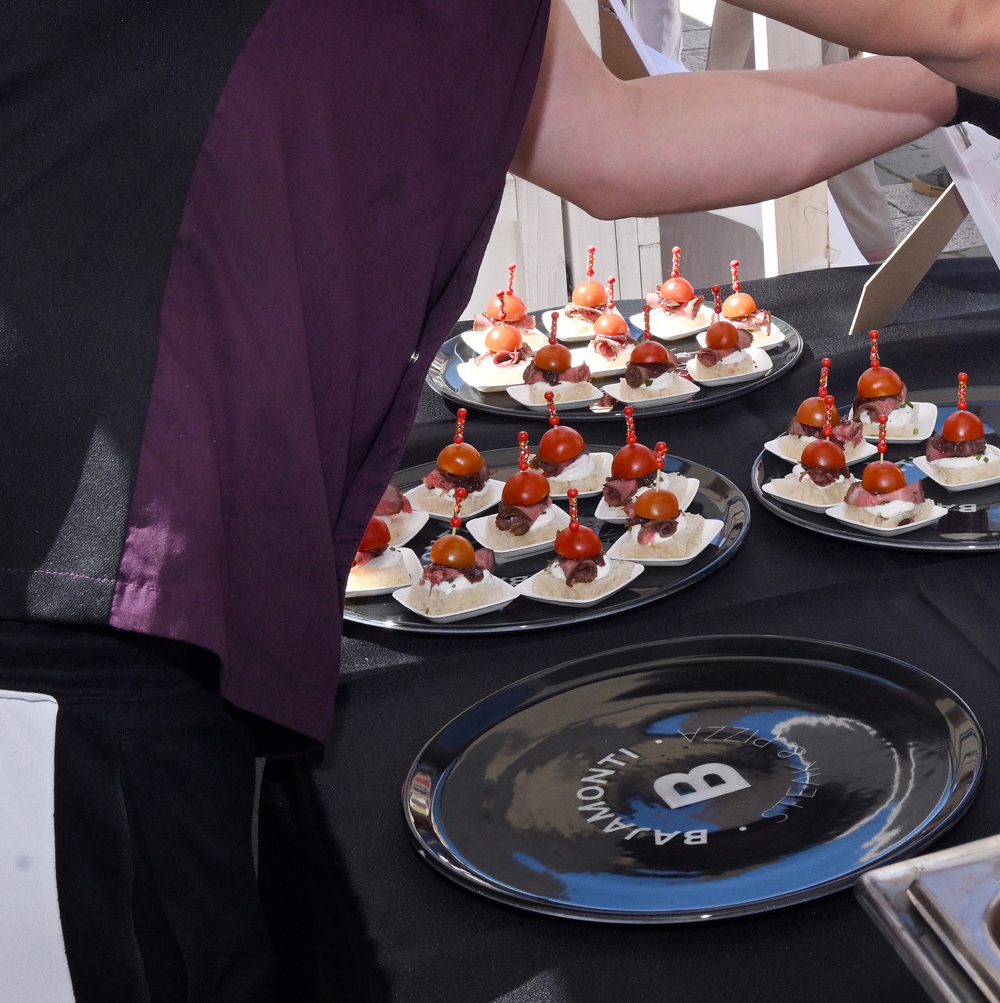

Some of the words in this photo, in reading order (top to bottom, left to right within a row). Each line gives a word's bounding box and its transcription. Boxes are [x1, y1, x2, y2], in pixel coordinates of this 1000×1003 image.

[677, 726, 780, 748] PIZZA
[576, 748, 708, 846] BAJAMONTI
[653, 763, 751, 809] B
[762, 761, 821, 823] STEAK
